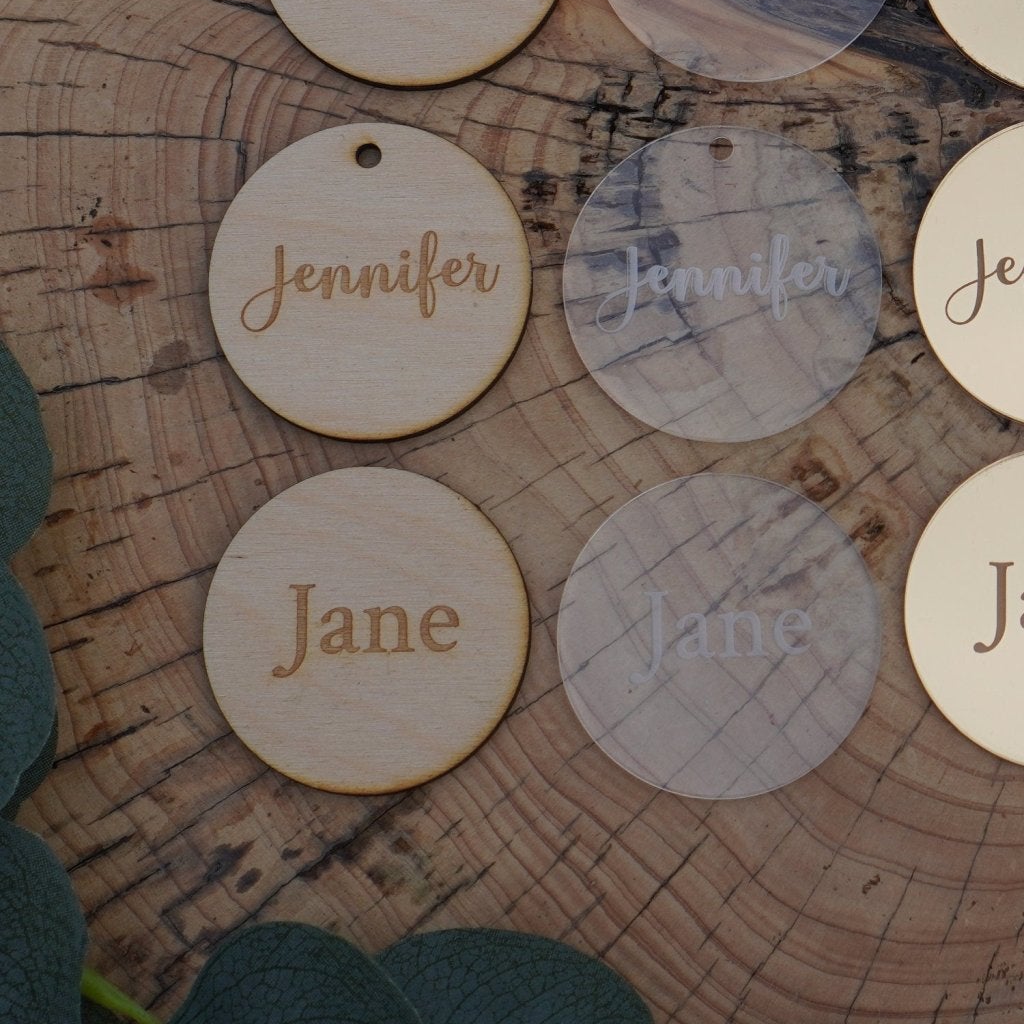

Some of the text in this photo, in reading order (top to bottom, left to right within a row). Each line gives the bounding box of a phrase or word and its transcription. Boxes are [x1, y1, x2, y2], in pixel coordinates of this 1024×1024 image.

[240, 230, 501, 333] Jennifer
[596, 234, 852, 334] Jennifer
[272, 583, 460, 679] Jane
[629, 589, 812, 685] Jane
